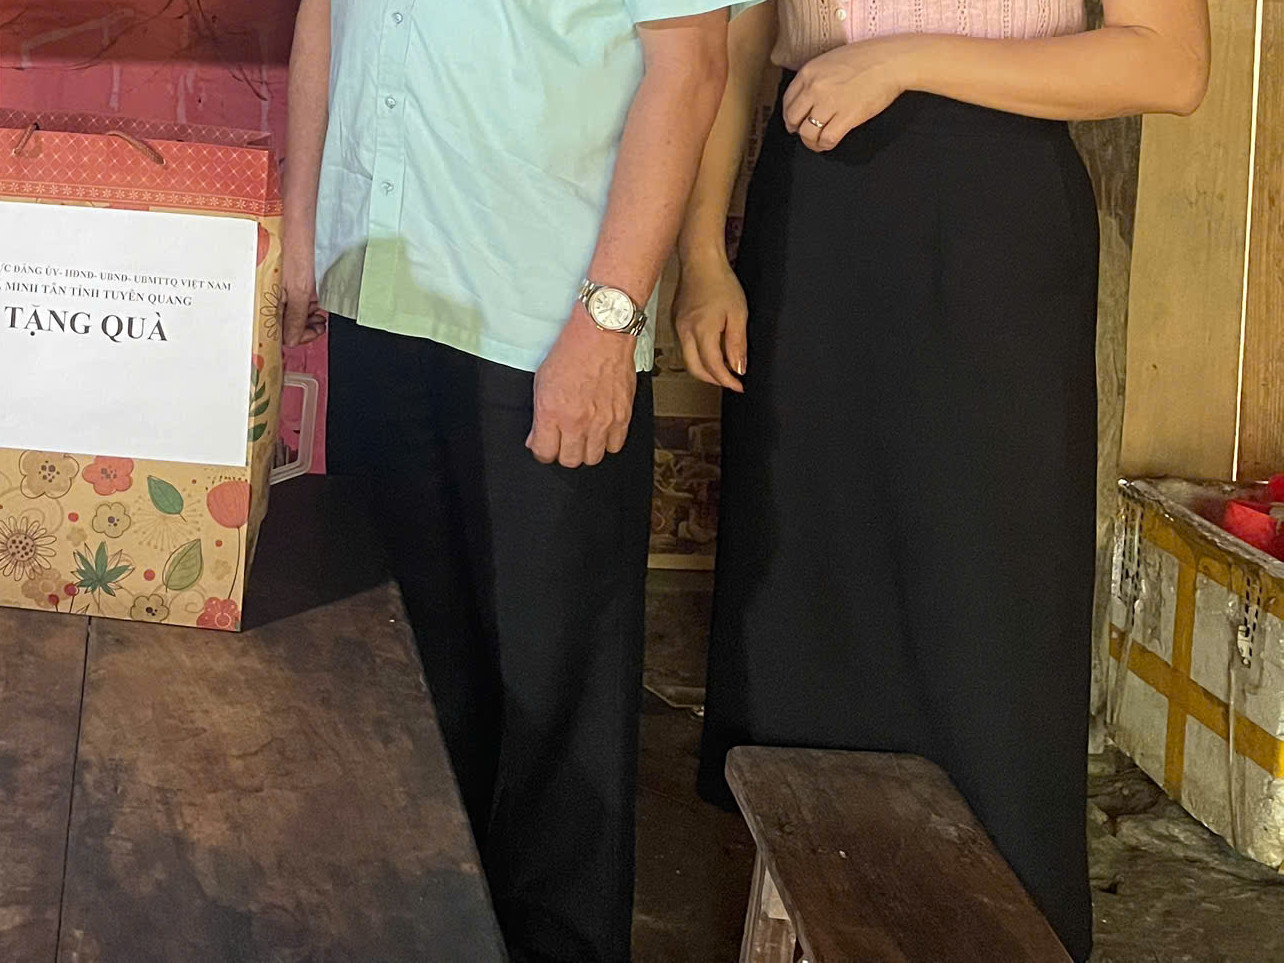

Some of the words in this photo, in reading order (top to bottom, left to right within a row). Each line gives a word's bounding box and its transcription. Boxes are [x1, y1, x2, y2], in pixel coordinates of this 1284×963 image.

[5, 281, 38, 293] MINH
[41, 282, 67, 296] TÂN
[70, 285, 99, 298] TỈNH
[103, 288, 144, 302] TUYÊN
[148, 293, 192, 306] QUANG
[134, 275, 179, 287] UBMTTQ
[181, 278, 205, 290] VIỆT
[207, 280, 231, 291] NAM
[4, 304, 92, 337] TẶNG
[101, 312, 168, 343] QUÀ
